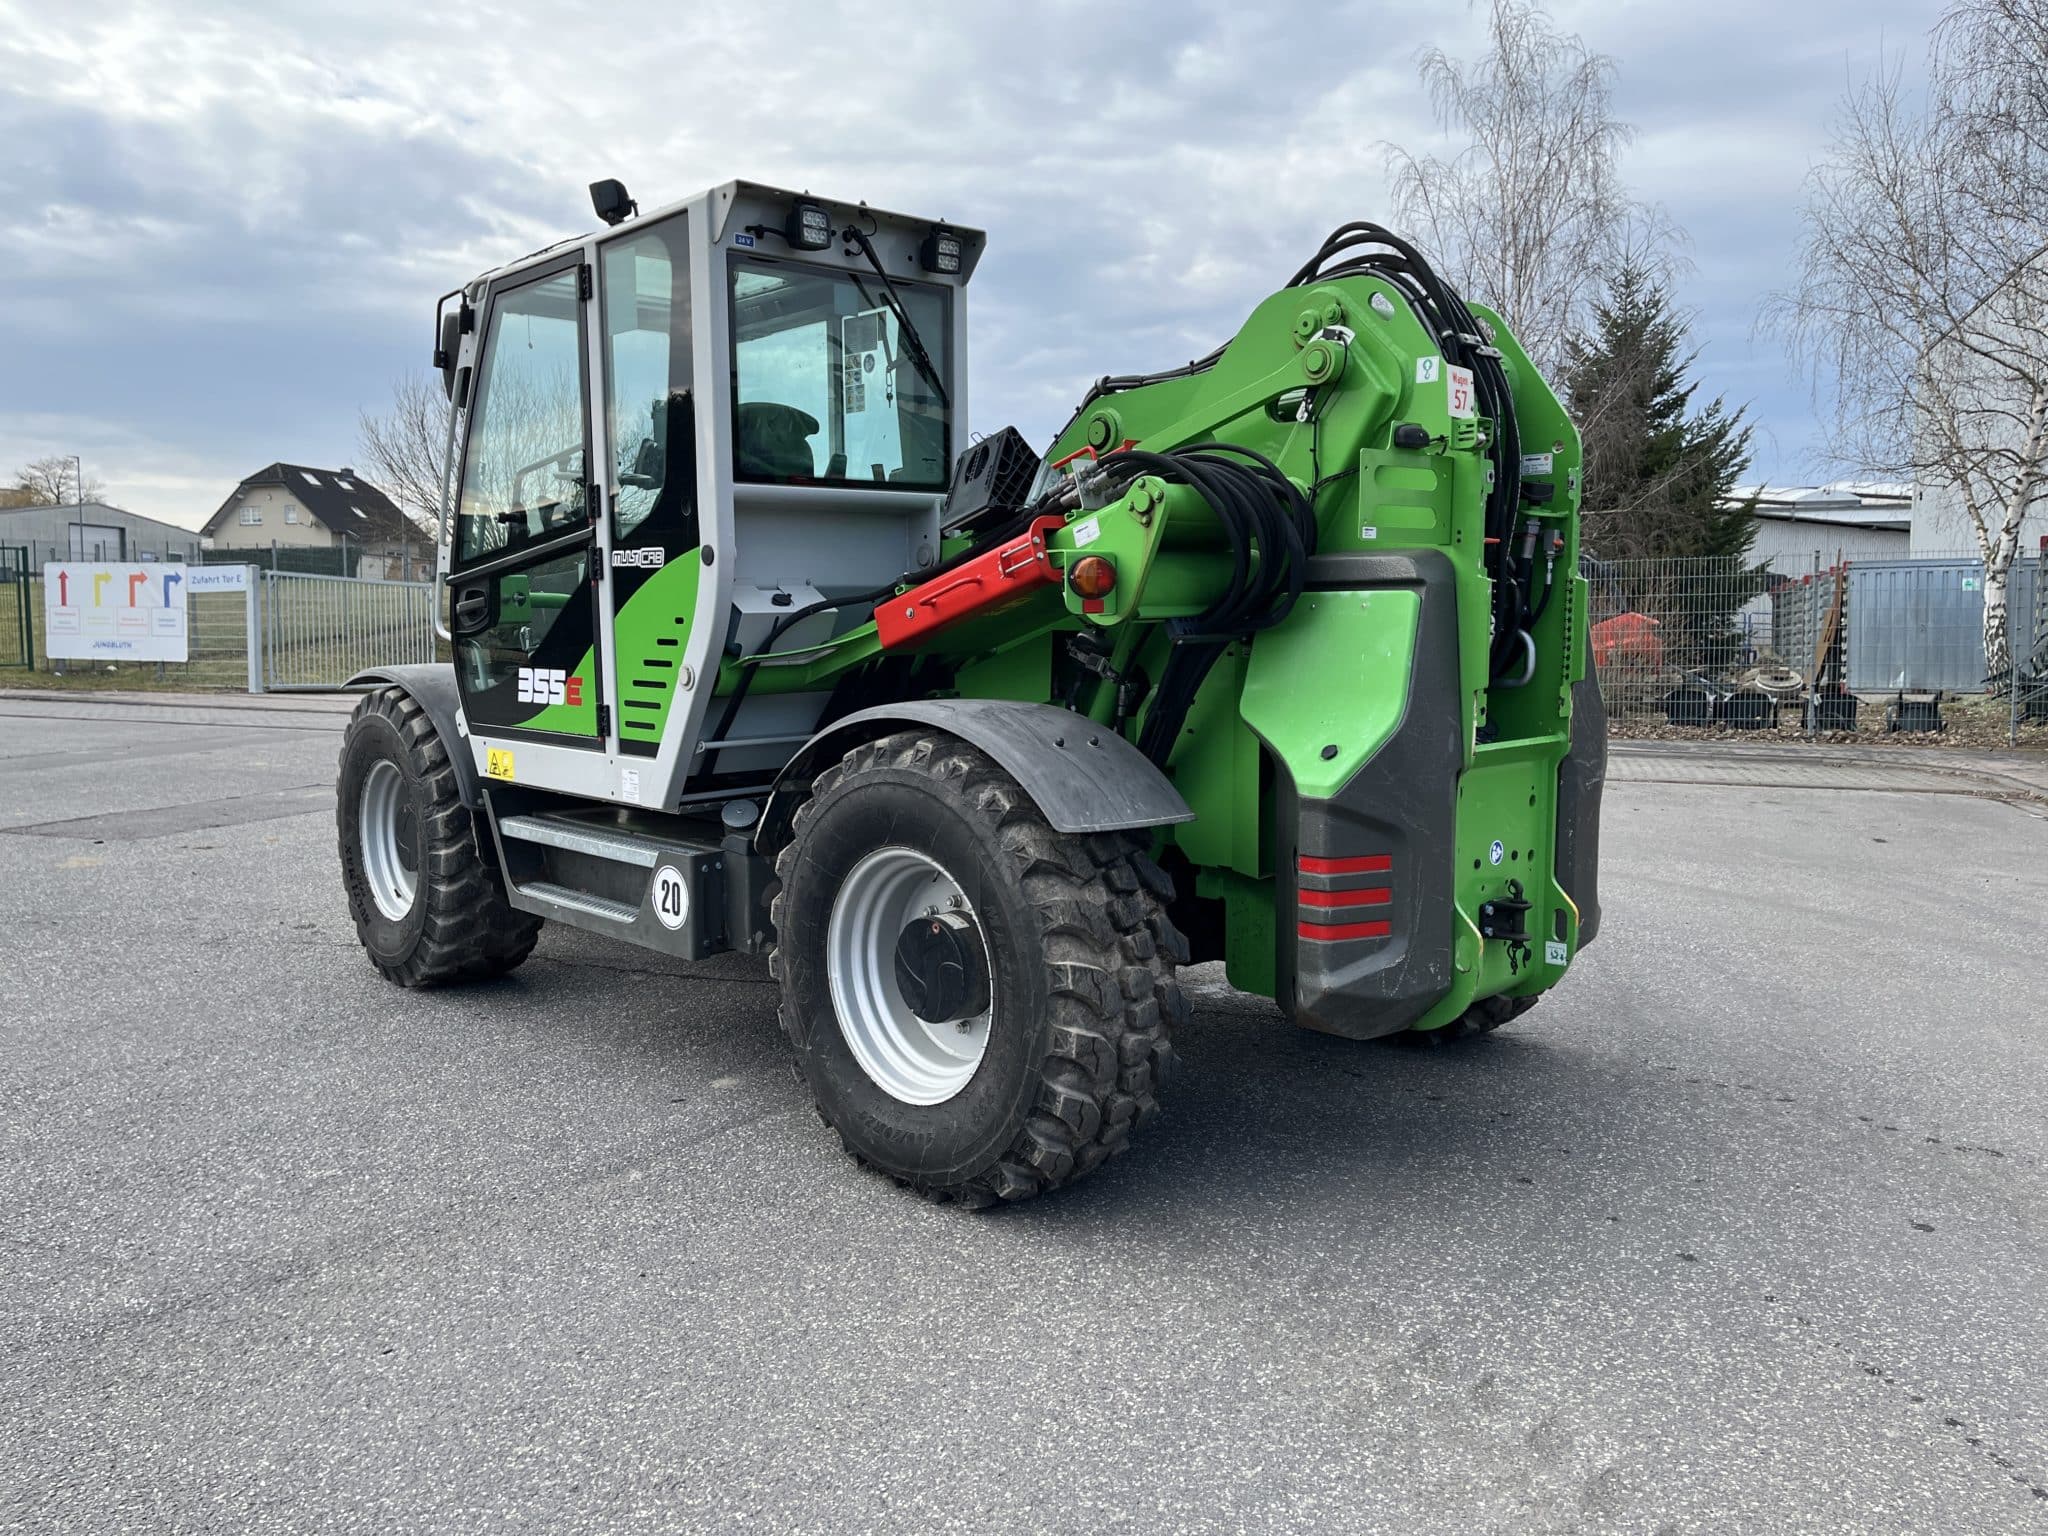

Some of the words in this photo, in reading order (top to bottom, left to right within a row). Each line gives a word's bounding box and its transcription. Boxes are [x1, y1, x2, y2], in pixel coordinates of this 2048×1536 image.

[1452, 371, 1469, 387] Wagen
[1454, 389, 1468, 411] 57
[191, 575, 221, 585] Zufahrt
[222, 575, 236, 584] Tor
[236, 574, 242, 583] E
[661, 879, 681, 917] 20
